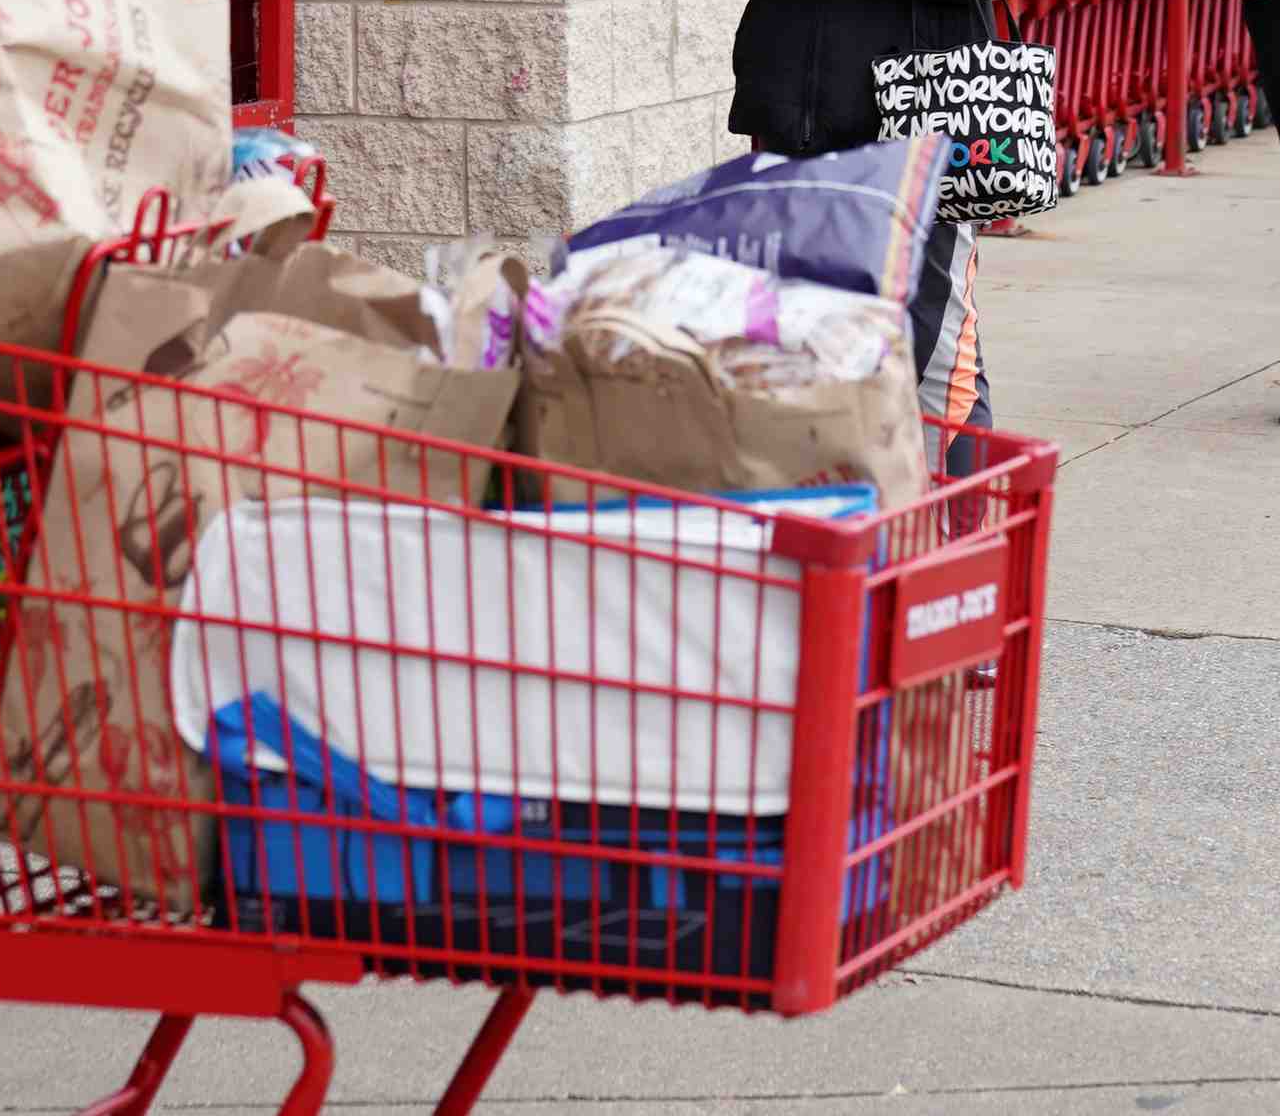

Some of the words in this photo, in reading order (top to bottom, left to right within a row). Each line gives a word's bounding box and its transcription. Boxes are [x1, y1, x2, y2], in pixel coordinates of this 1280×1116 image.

[914, 46, 970, 79] NEW
[933, 75, 1014, 106] YORK
[910, 104, 970, 140] NEW
[948, 137, 1014, 168] ORK
